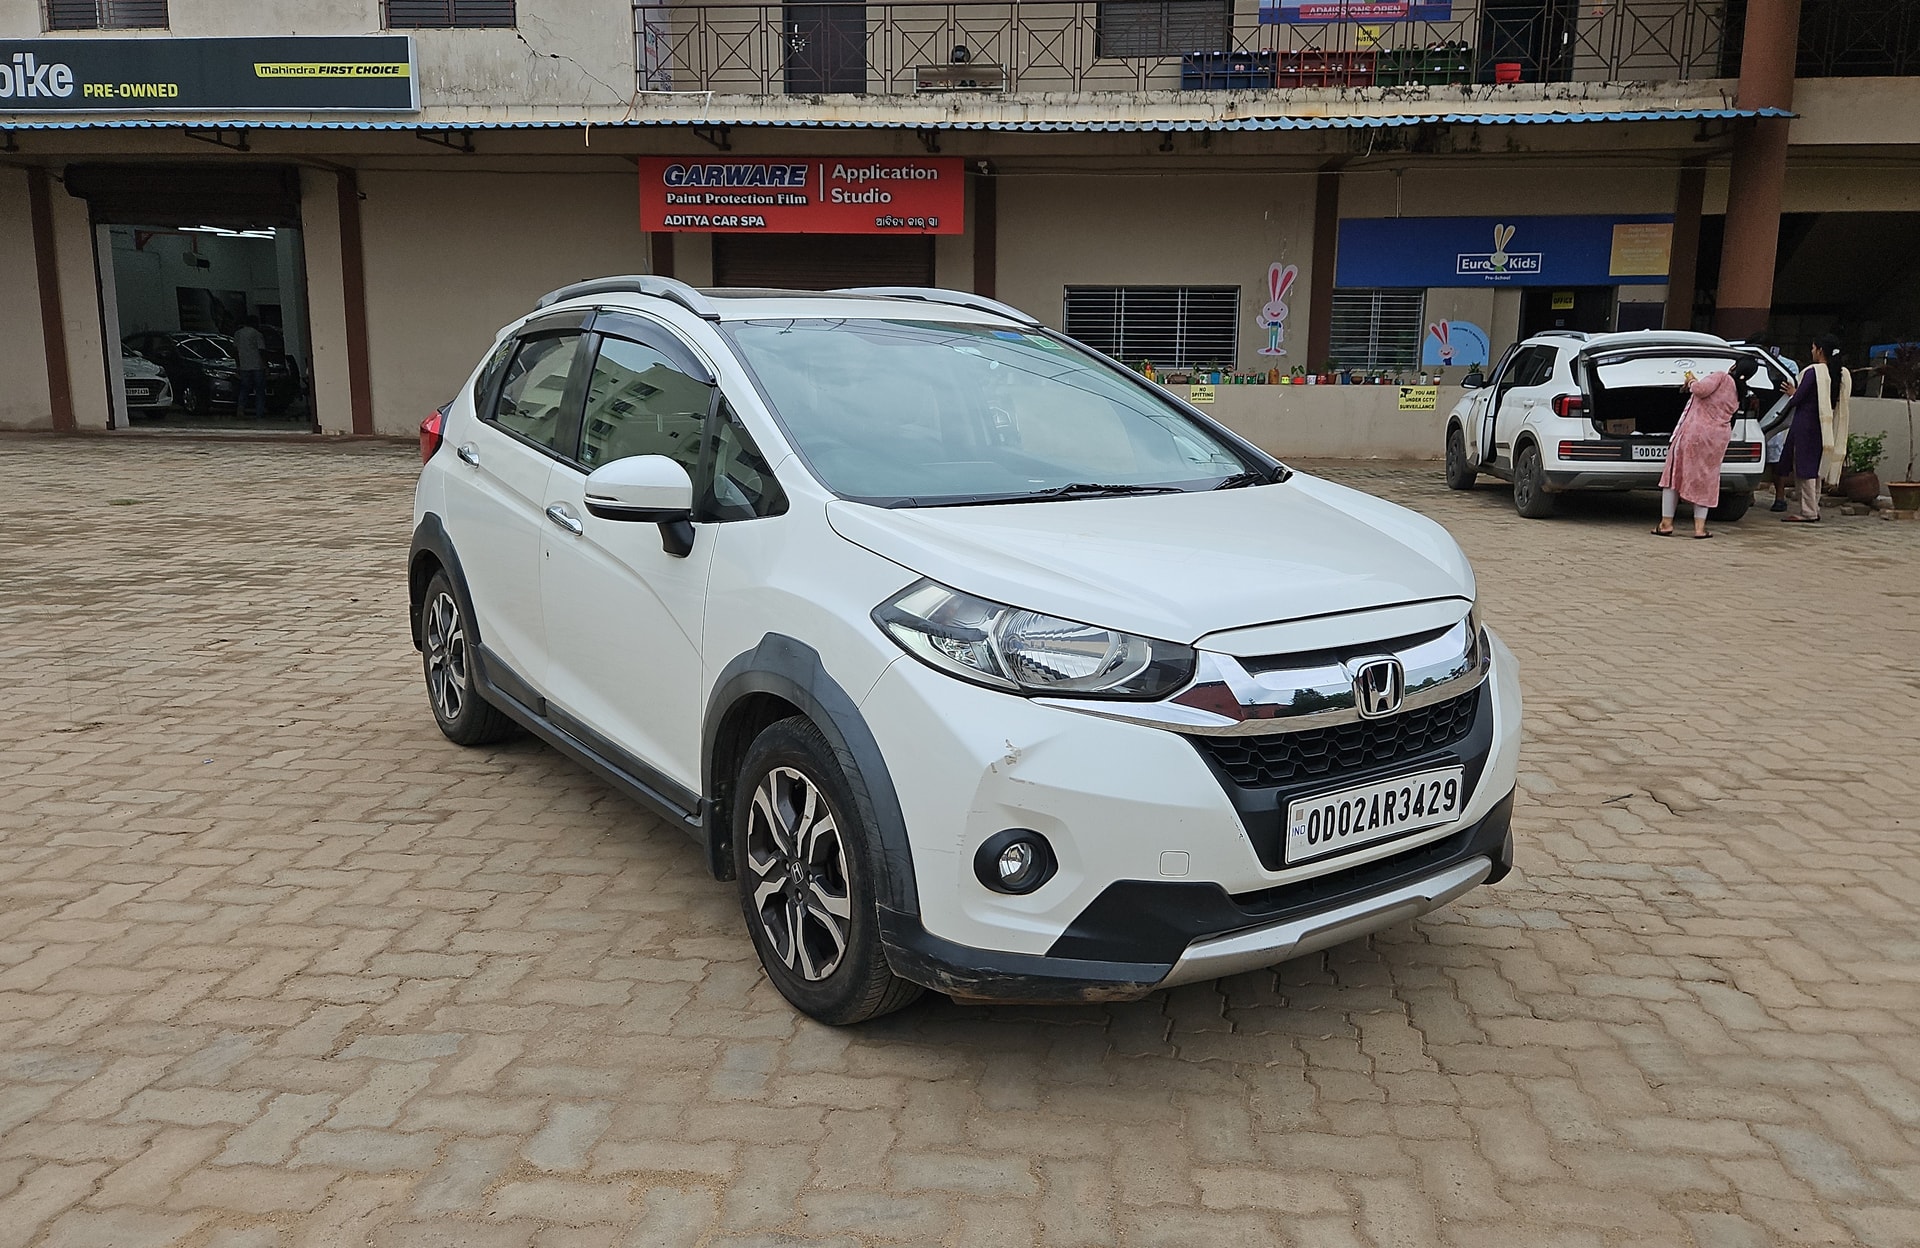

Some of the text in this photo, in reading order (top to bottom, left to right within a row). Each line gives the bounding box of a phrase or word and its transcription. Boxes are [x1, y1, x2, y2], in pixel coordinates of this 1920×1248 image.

[1372, 5, 1401, 15] OPEN
[260, 65, 400, 75] Mahindra FIRST CHOICE
[83, 83, 179, 98] PRE-OWNED
[663, 164, 808, 187] GARWARE
[831, 164, 938, 184] Application
[666, 193, 807, 204] Paint Protection Film
[831, 187, 892, 203] Studio
[664, 215, 765, 227] ADITYA CAR SPA
[1462, 257, 1537, 270] Euro Kids
[1307, 778, 1458, 846] OD02AR3429
[1291, 824, 1306, 837] IND
